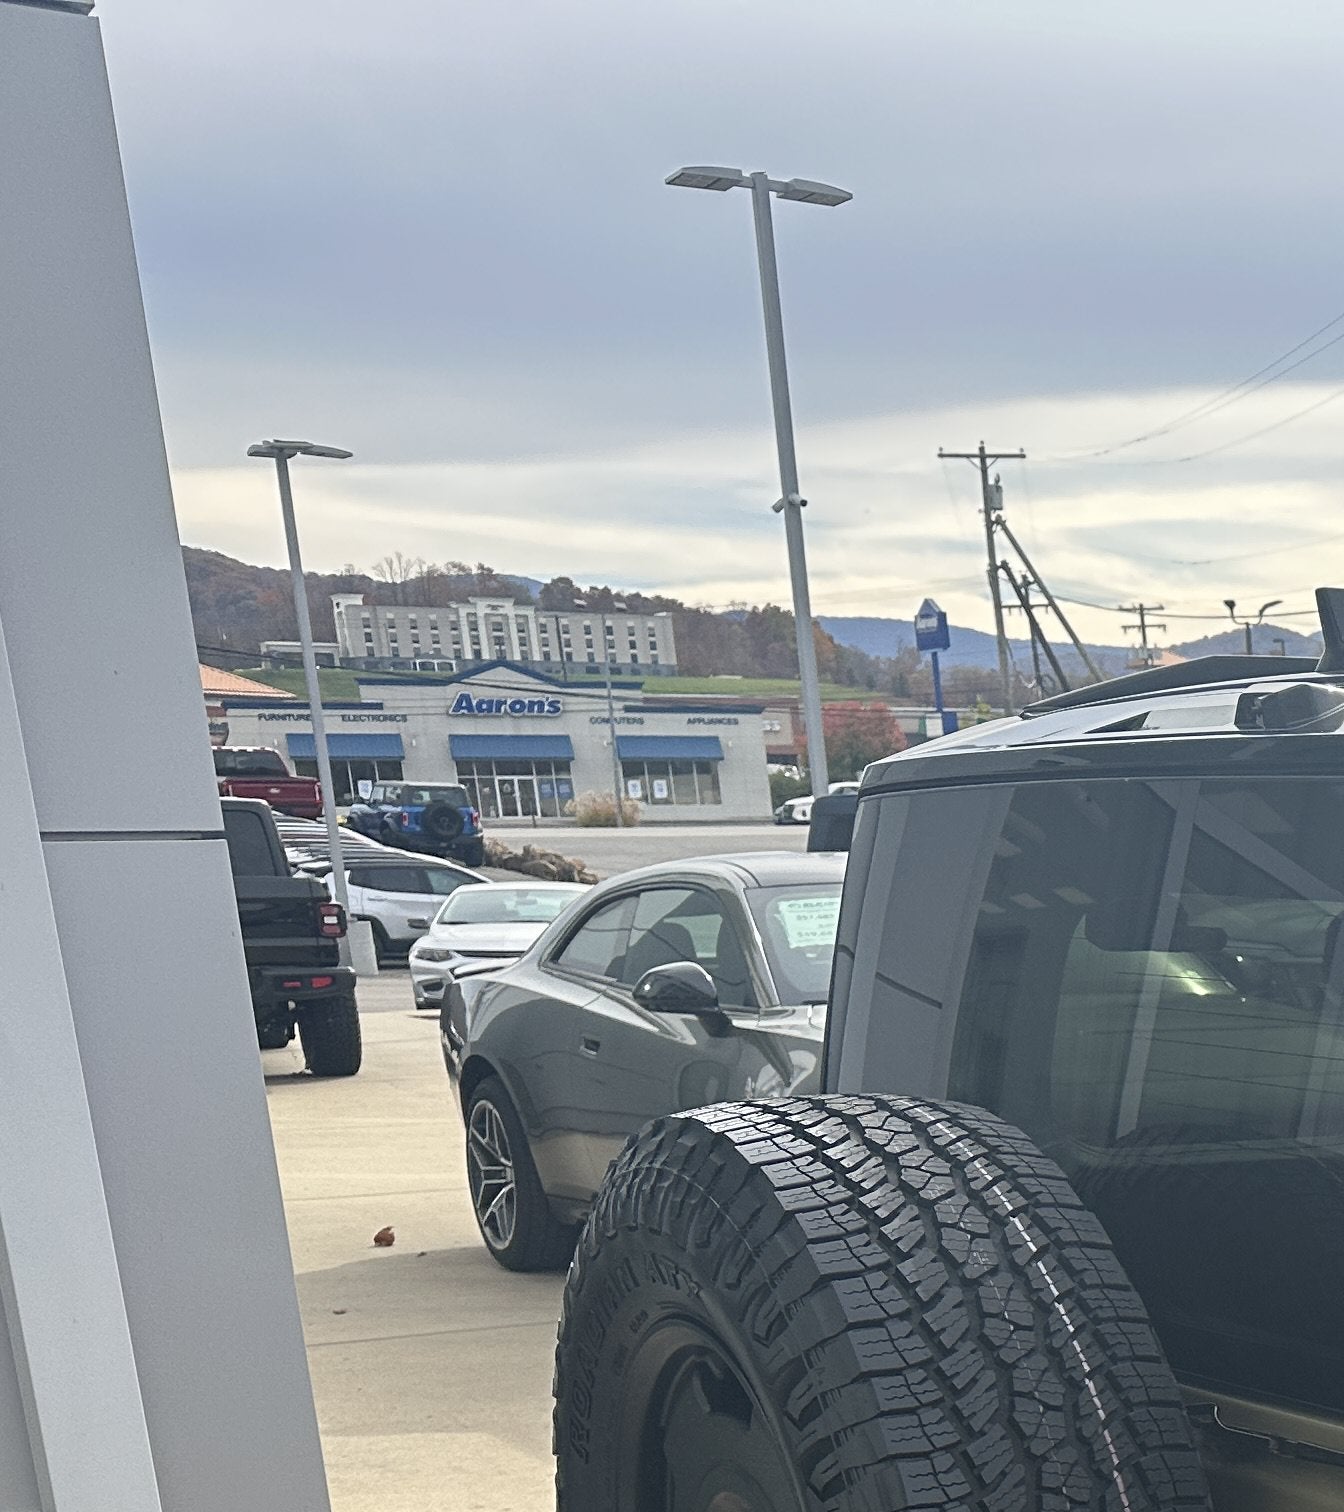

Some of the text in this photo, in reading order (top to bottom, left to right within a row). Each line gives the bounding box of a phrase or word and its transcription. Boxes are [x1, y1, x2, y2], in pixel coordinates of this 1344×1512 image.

[450, 692, 562, 716] Aaron's
[257, 712, 312, 721] FURNITURE
[341, 713, 408, 723] ELECTRONICS
[686, 717, 739, 725] APPLIANCES
